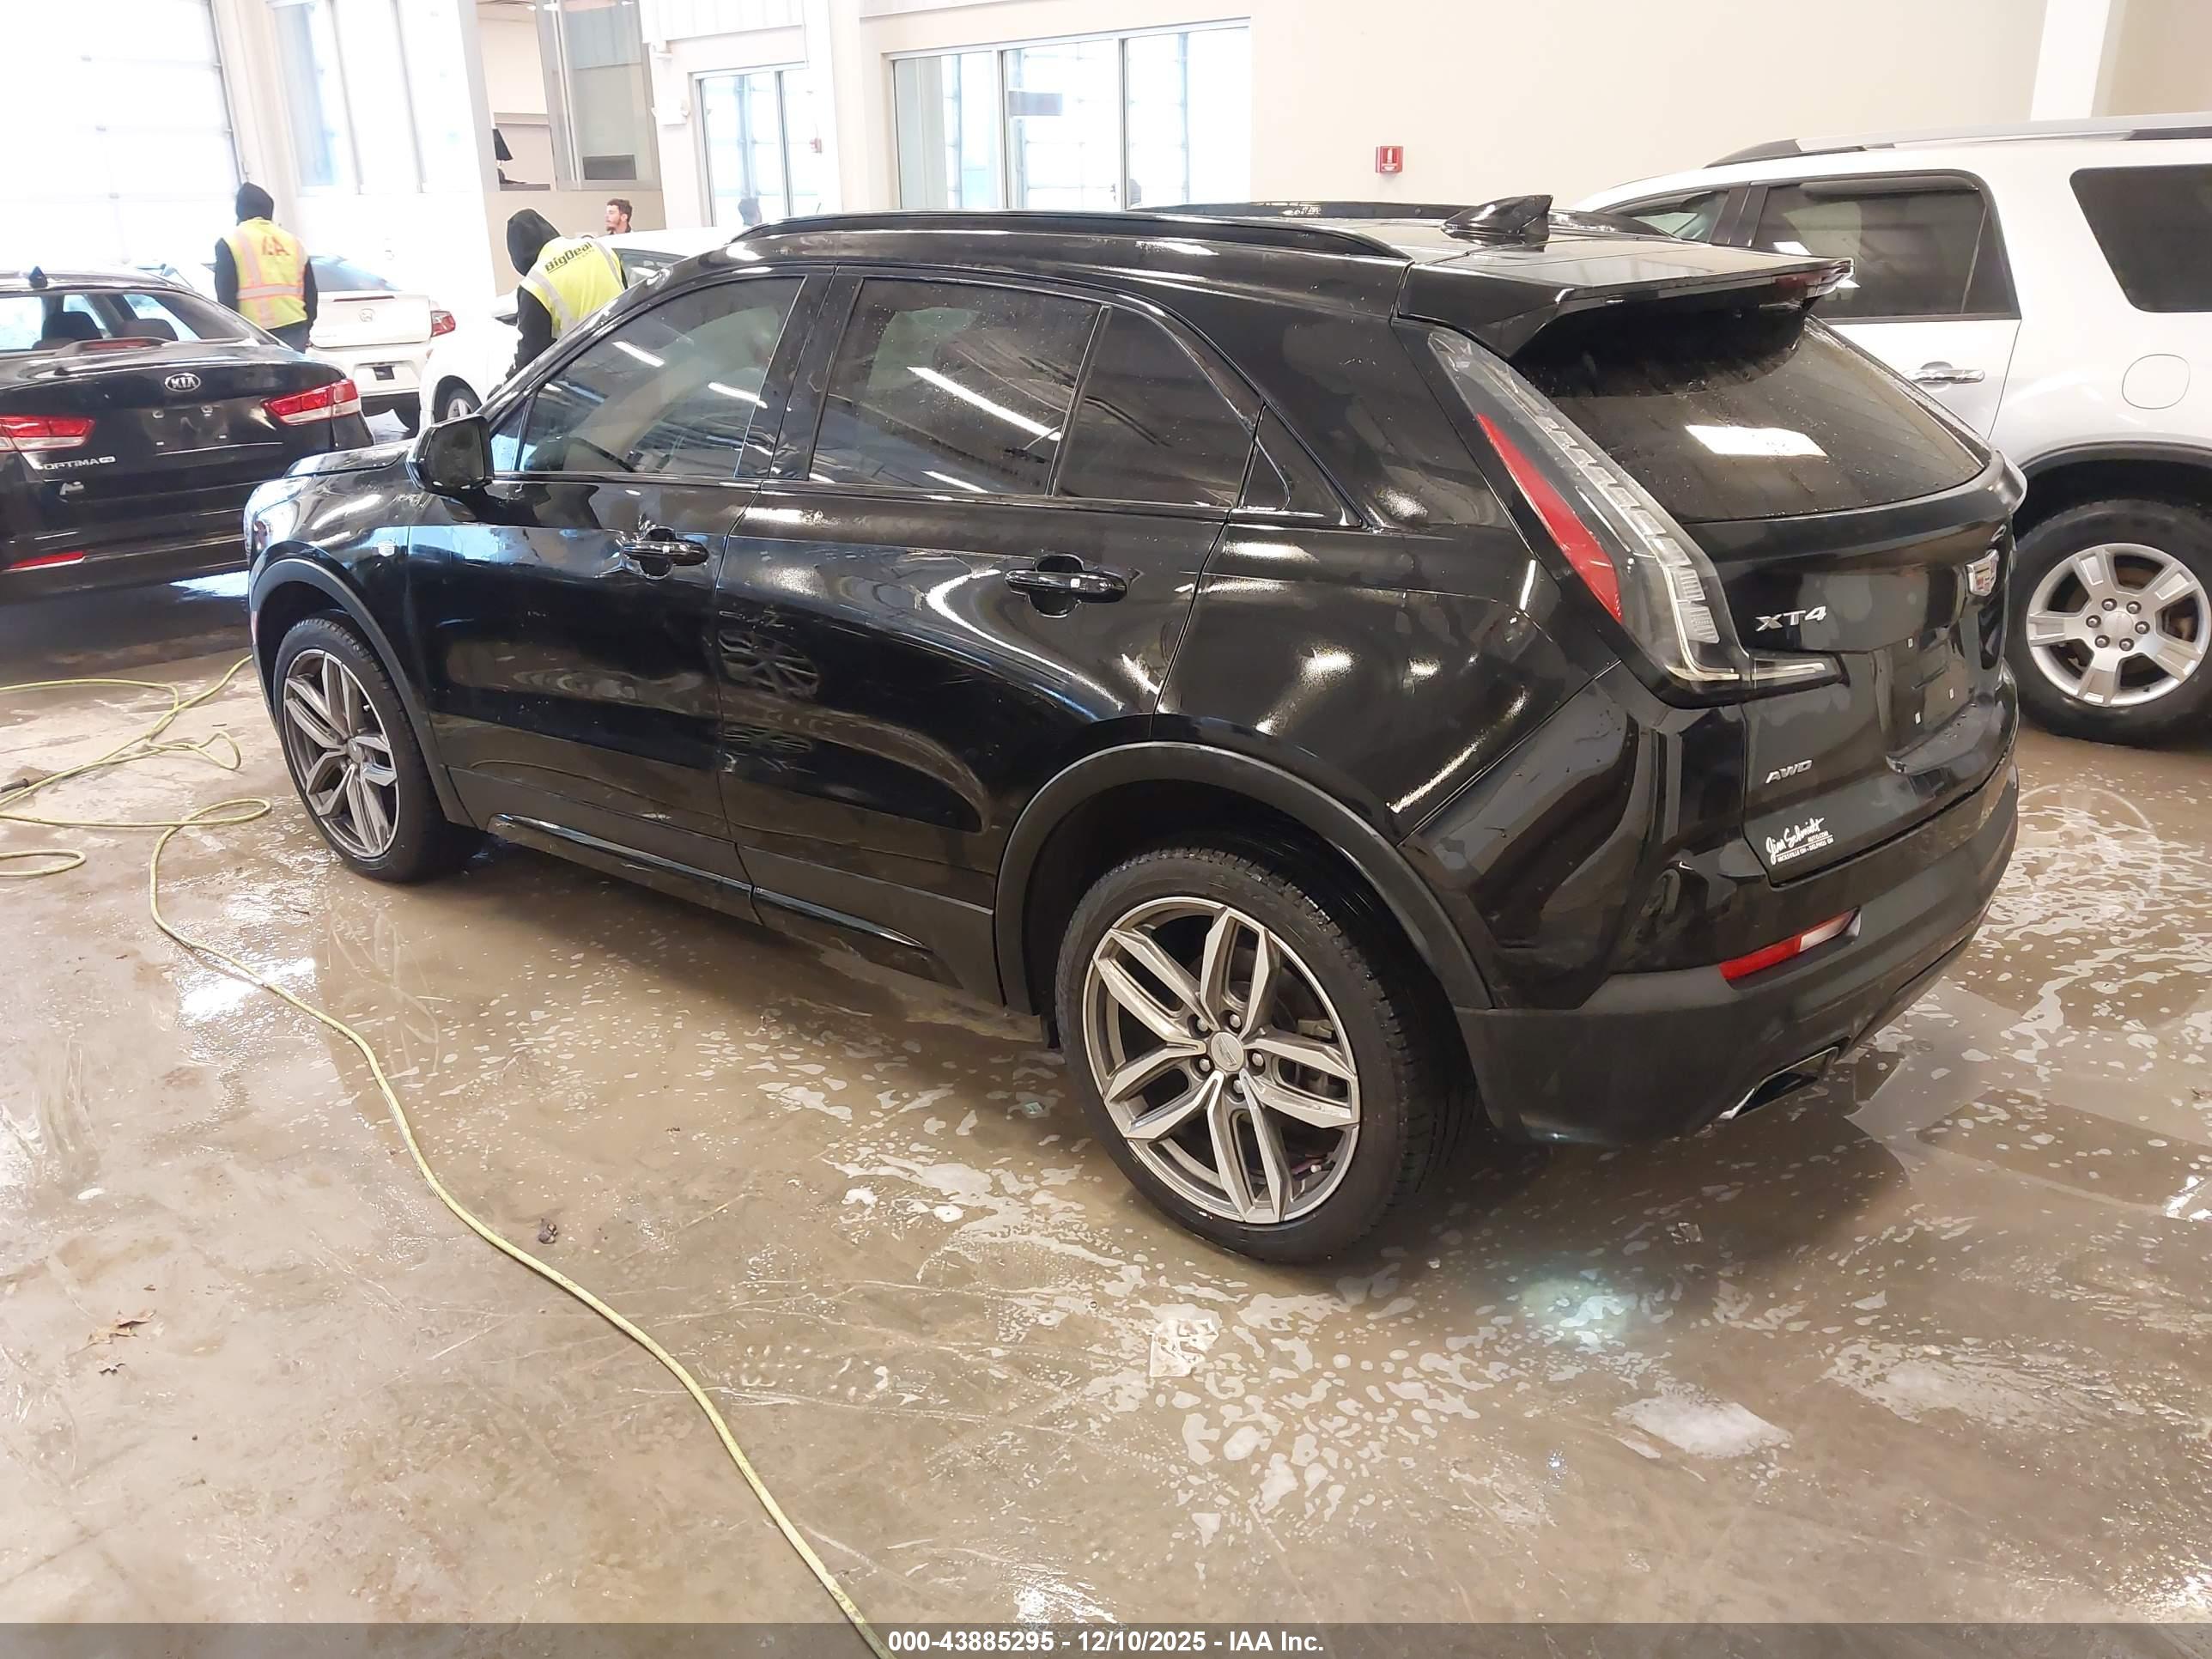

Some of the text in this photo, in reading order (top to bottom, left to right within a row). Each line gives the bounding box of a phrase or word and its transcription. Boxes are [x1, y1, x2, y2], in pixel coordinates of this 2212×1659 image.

[544, 241, 593, 273] BigDeal
[171, 375, 196, 389] KIA
[44, 458, 100, 471] OPTIMA
[1754, 605, 1827, 632] XT4
[1765, 759, 1813, 784] AWD
[1765, 817, 1825, 866] Jim Schmidt
